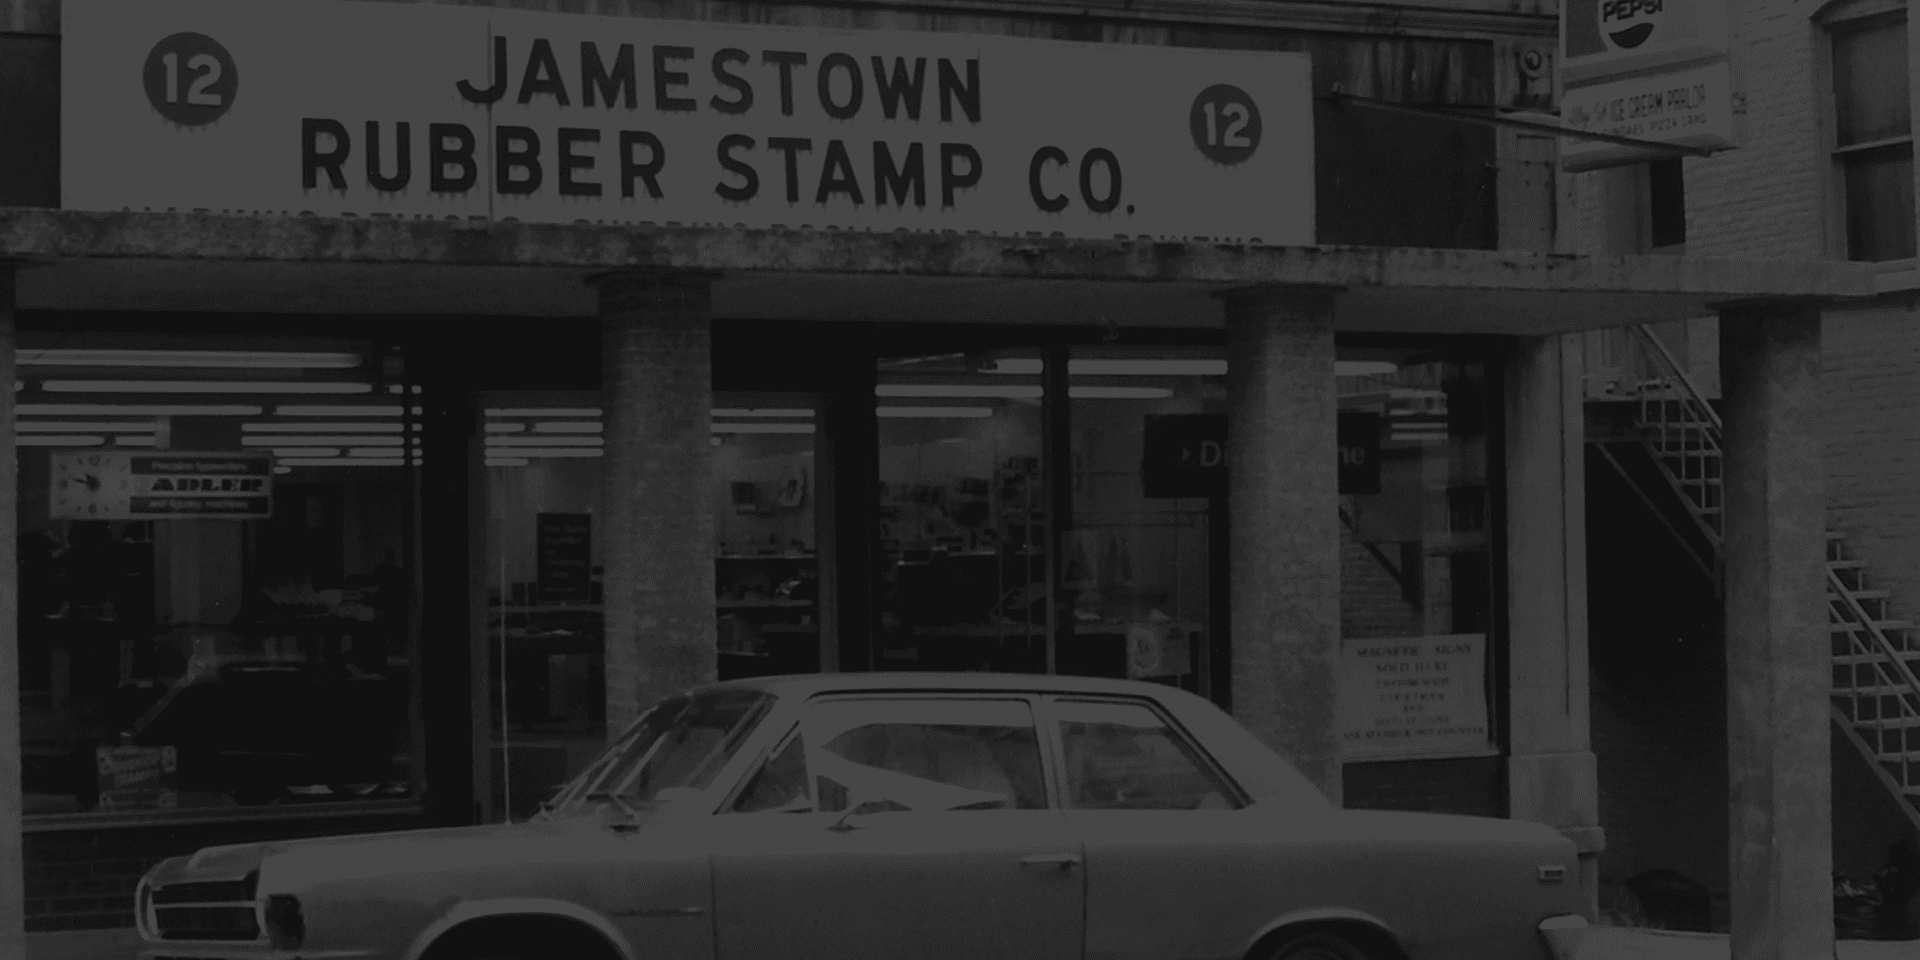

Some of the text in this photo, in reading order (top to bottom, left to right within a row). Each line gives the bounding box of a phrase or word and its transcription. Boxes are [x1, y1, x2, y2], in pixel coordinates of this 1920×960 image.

[1603, 0, 1663, 22] PEPSI
[163, 53, 222, 106] 12
[457, 36, 982, 122] JAMESTOWN
[1204, 102, 1251, 147] 12
[1628, 92, 1664, 119] CREAM
[302, 118, 1137, 216] RUBBER STAMP CO.
[151, 478, 263, 491] ADLER
